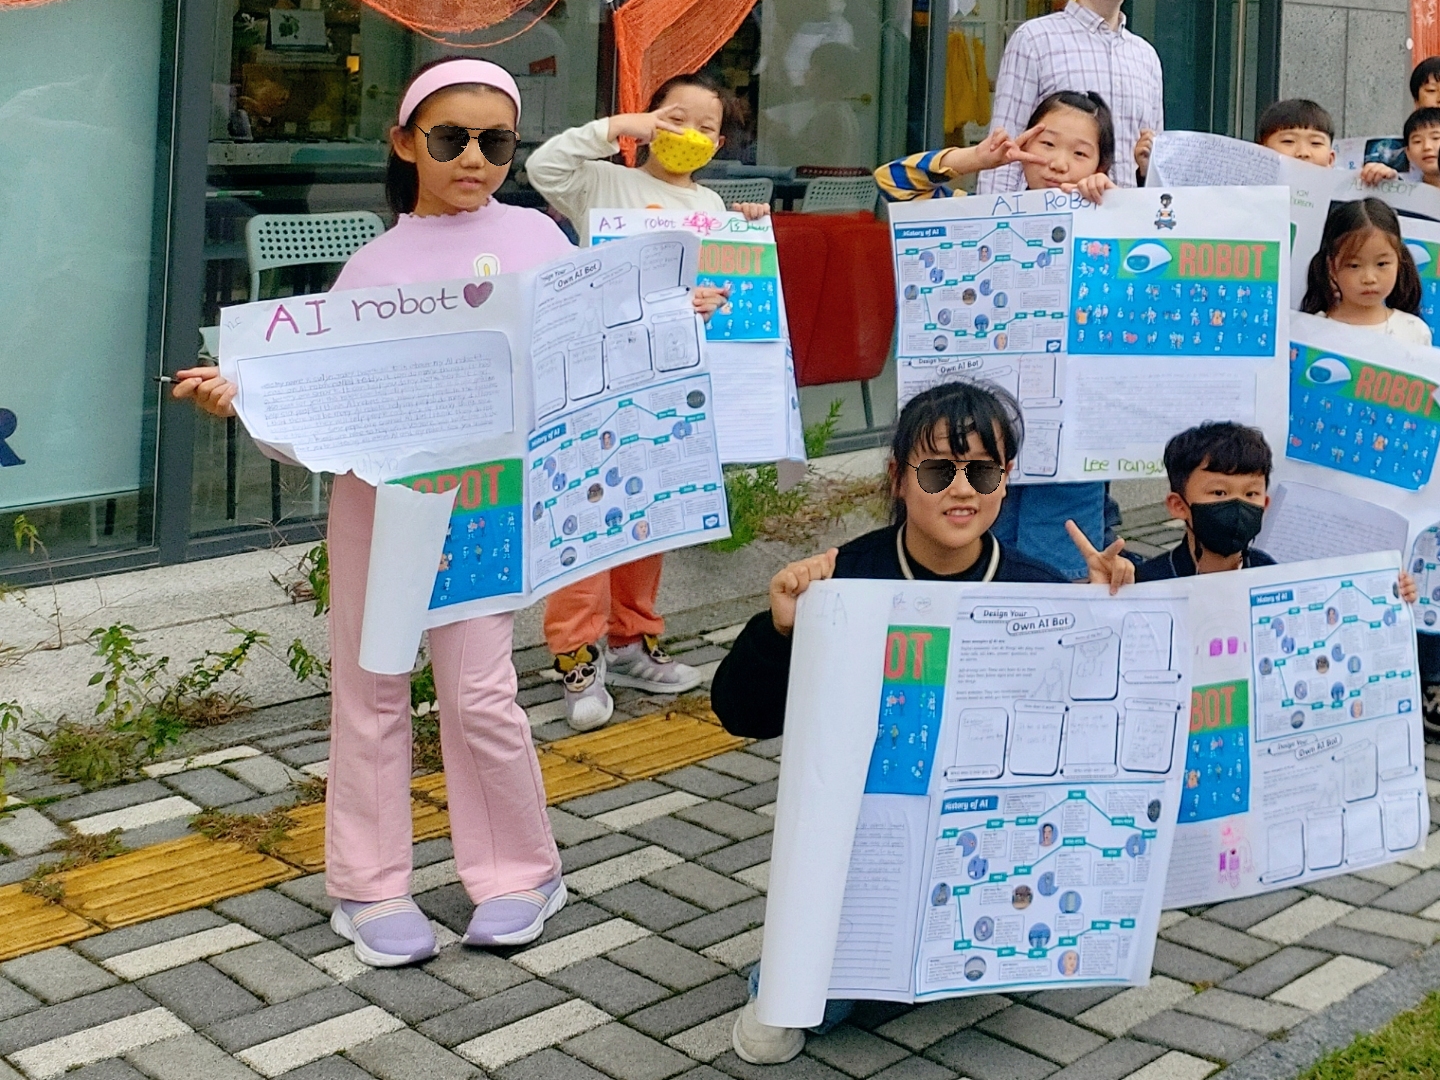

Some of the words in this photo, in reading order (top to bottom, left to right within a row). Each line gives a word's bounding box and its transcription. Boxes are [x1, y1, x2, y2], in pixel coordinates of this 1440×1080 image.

[992, 194, 1027, 215] AI
[599, 216, 626, 230] AI
[644, 216, 676, 229] robot
[1180, 243, 1268, 279] ROBOT
[266, 299, 331, 342] AI
[351, 288, 458, 322] robot
[1355, 366, 1440, 417] ROBOT
[1083, 456, 1110, 472] Lee
[983, 609, 1008, 619] Design
[1012, 621, 1036, 632] Own
[1038, 619, 1050, 629] AI
[1052, 617, 1069, 627] Bot
